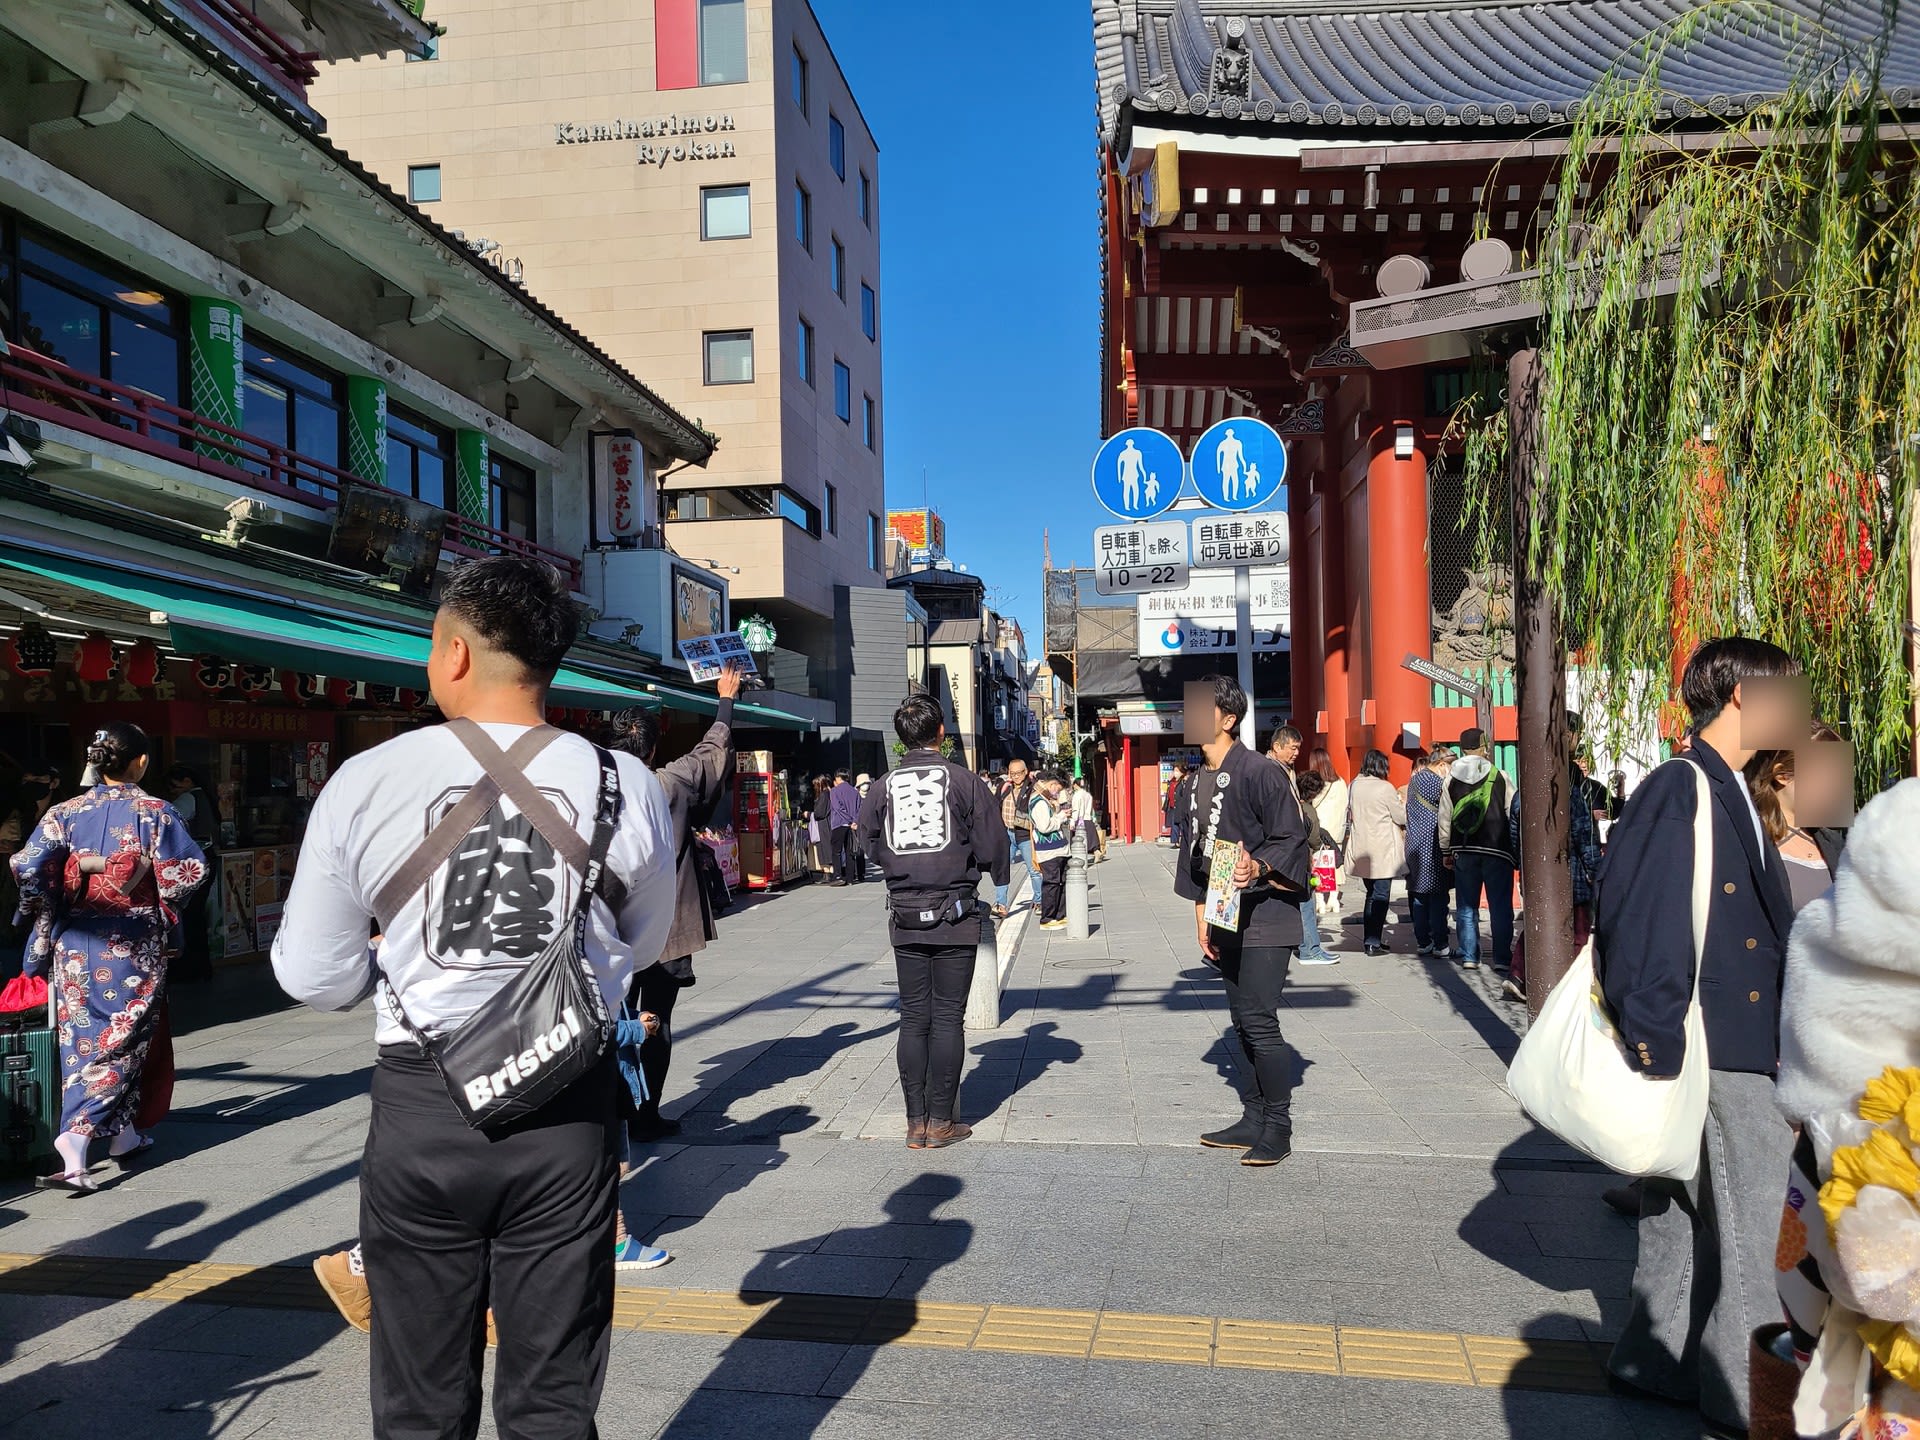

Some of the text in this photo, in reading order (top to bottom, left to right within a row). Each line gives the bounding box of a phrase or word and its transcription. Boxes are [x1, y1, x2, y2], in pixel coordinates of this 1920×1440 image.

[555, 113, 736, 145] Kaminarimon
[638, 138, 737, 169] Ryokan
[1101, 530, 1141, 550] 自転車
[1200, 520, 1280, 541] 自転車を除く
[1148, 537, 1180, 555] を除く
[1200, 542, 1281, 562] 仲見世通り
[1102, 549, 1141, 568] 人力車
[1210, 594, 1268, 609] 整備事
[1414, 658, 1461, 683] KAMINARIMON
[1459, 678, 1479, 692] GATE
[463, 1004, 582, 1112] Bristol
